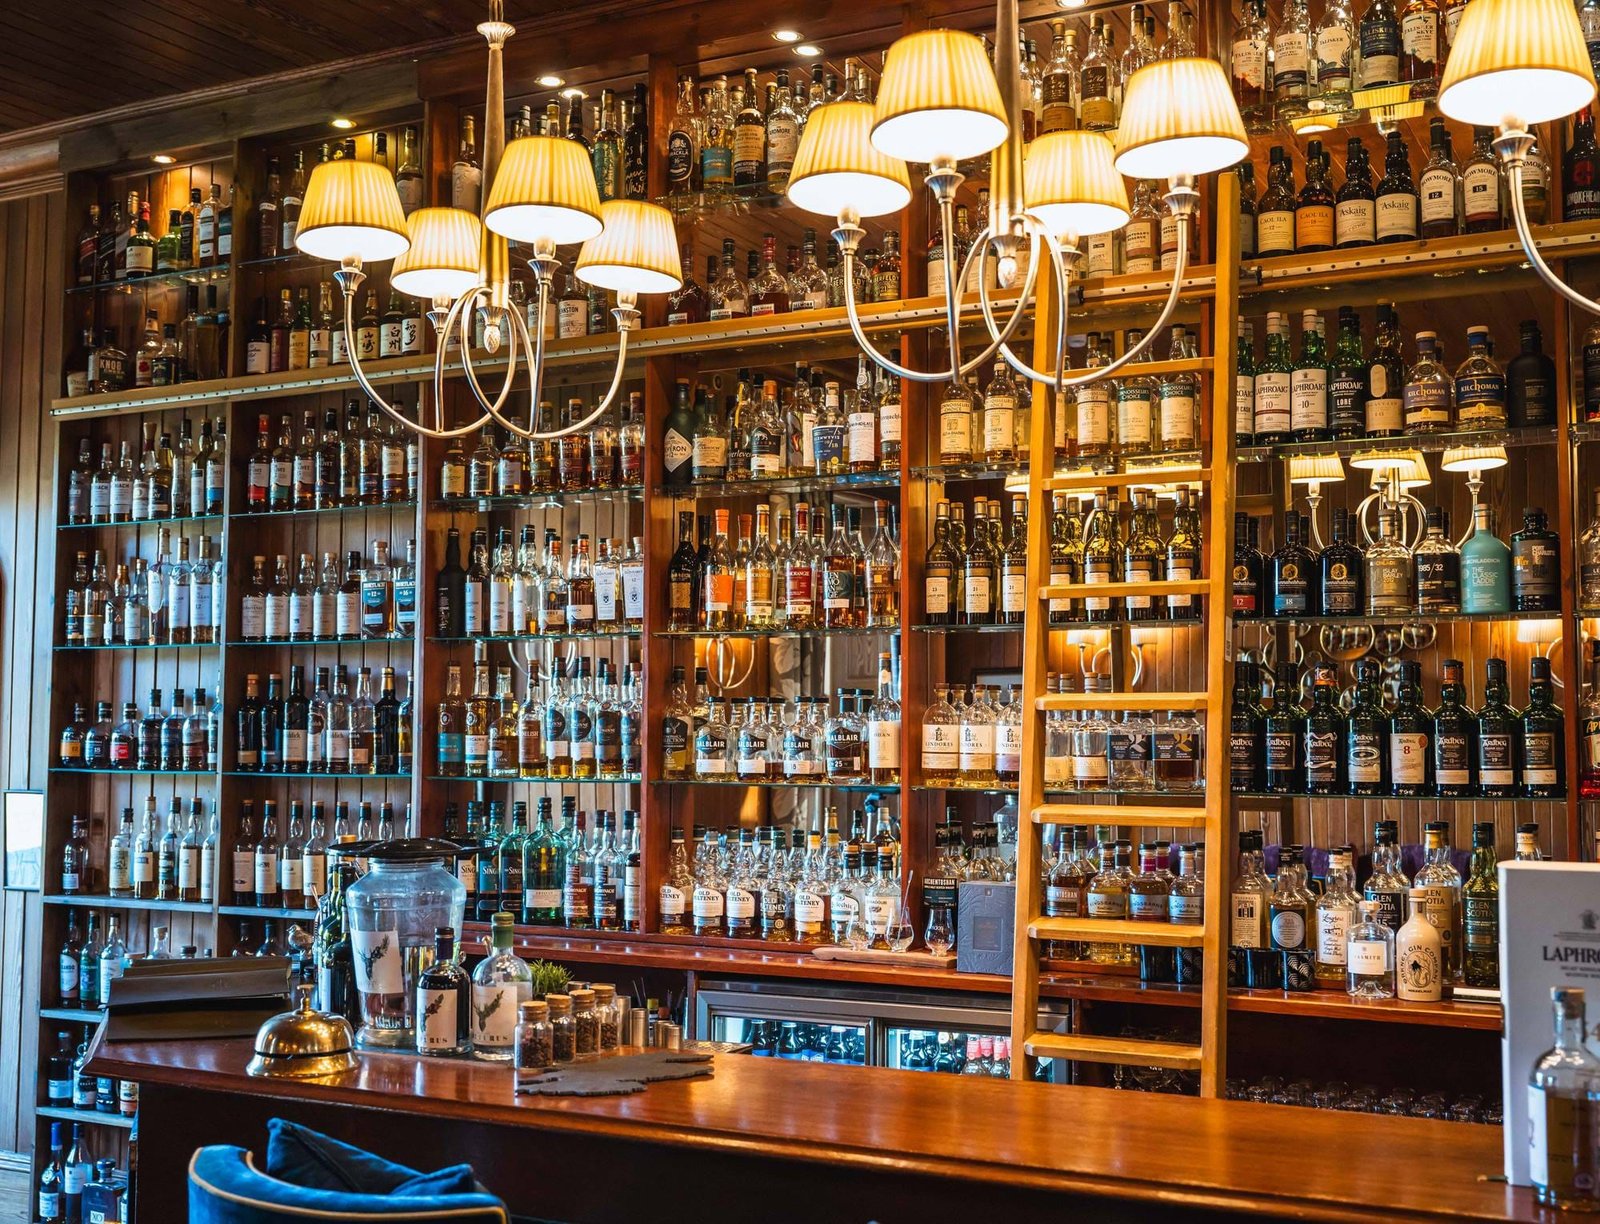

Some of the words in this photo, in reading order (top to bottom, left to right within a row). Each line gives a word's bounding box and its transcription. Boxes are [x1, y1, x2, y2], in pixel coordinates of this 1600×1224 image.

[1464, 168, 1497, 181] BOWMORE
[1421, 175, 1453, 186] BOWMORE
[1382, 199, 1410, 211] Askaig
[1340, 207, 1367, 217] Askaig
[100, 359, 122, 369] KNOB
[1291, 383, 1326, 394] LAPHROAIG
[1328, 381, 1364, 393] LAPHROAIG
[1301, 400, 1310, 409] 10
[1336, 398, 1352, 406] LORE
[1267, 736, 1291, 747] Ardbeg
[1438, 736, 1466, 746] Ardbeg
[1481, 738, 1508, 748] Ardbeg
[1403, 746, 1411, 755] 8
[1371, 894, 1392, 903] GLEN
[1468, 900, 1490, 911] GLEN
[1466, 908, 1494, 919] SCOTIA
[1408, 944, 1423, 952] GIN
